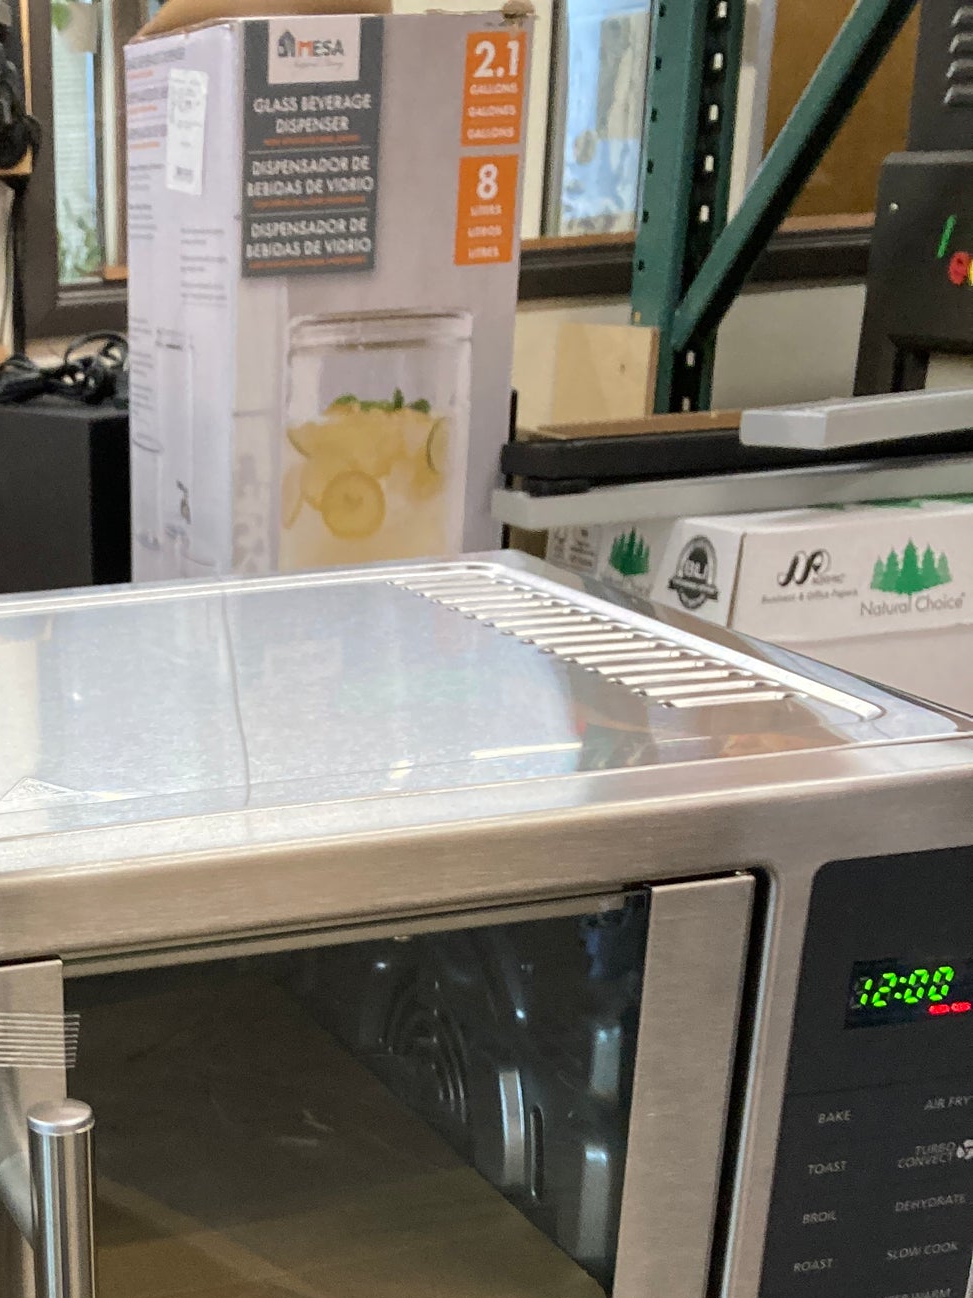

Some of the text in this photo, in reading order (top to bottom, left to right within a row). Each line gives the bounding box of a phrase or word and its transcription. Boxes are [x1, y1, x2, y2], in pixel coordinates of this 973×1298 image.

[473, 40, 520, 78] 2.1
[253, 93, 371, 113] GLASS BEVERAGE
[276, 115, 350, 134] DISPENSER
[252, 155, 371, 176] DISPENSADOR DE
[305, 178, 323, 195] DE
[476, 163, 499, 200] 8
[349, 217, 367, 232] DE
[304, 239, 322, 255] DE
[860, 596, 913, 617] Natural
[859, 965, 956, 1008] 12:00
[923, 1097, 946, 1111] AIR
[818, 1110, 852, 1124] BAKE
[808, 1160, 847, 1175] TOAST
[895, 1193, 966, 1212] DEHYDRATE
[887, 1241, 959, 1261] SLOW COOK
[793, 1257, 833, 1272] ROAST
